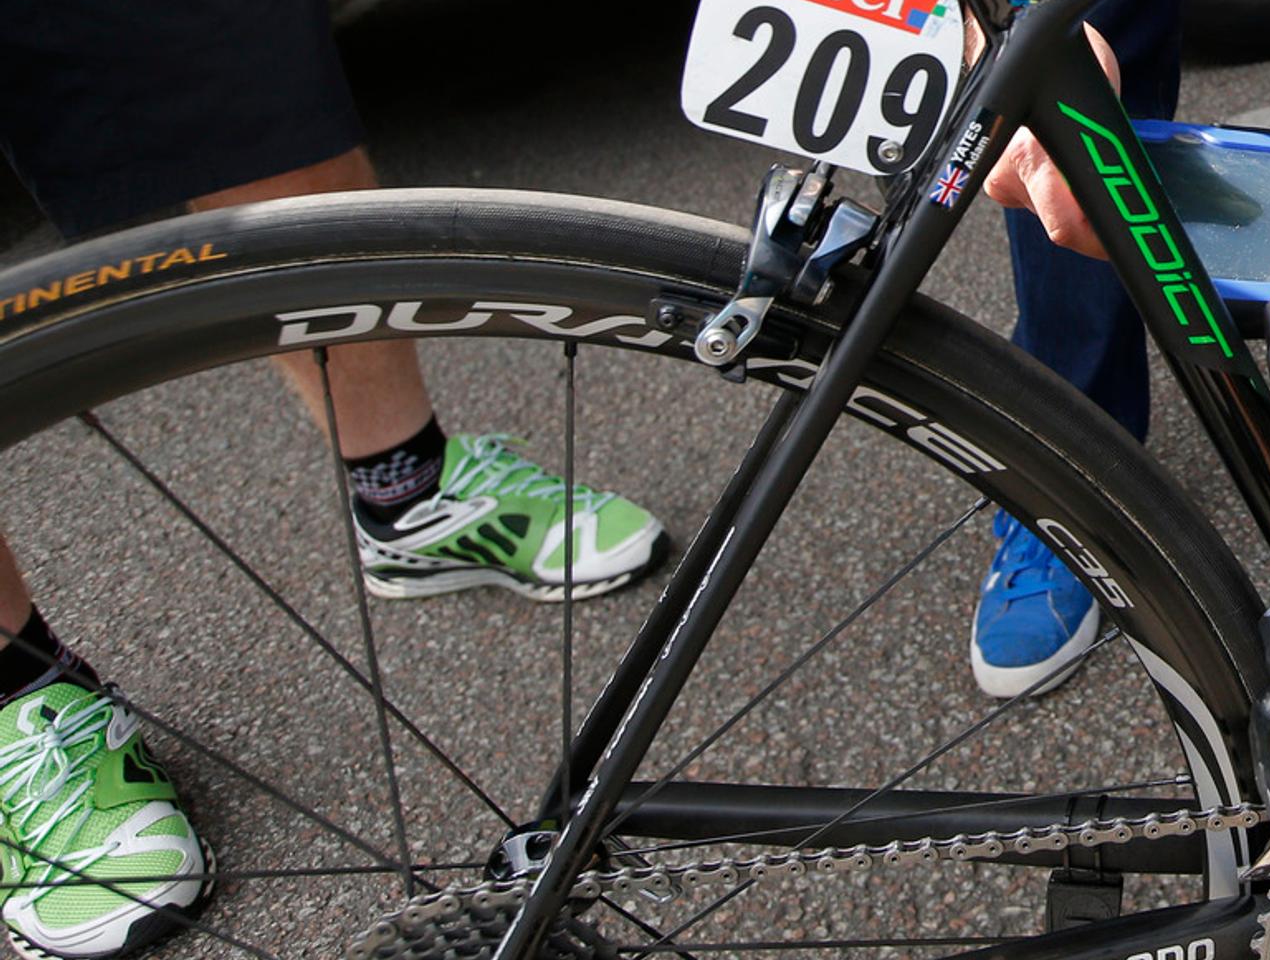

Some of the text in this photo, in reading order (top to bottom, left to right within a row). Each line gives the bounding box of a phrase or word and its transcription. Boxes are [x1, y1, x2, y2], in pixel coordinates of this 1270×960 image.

[702, 5, 949, 174] 209
[950, 121, 982, 162] YATES
[964, 136, 990, 170] Adam
[1036, 517, 1135, 608] C35
